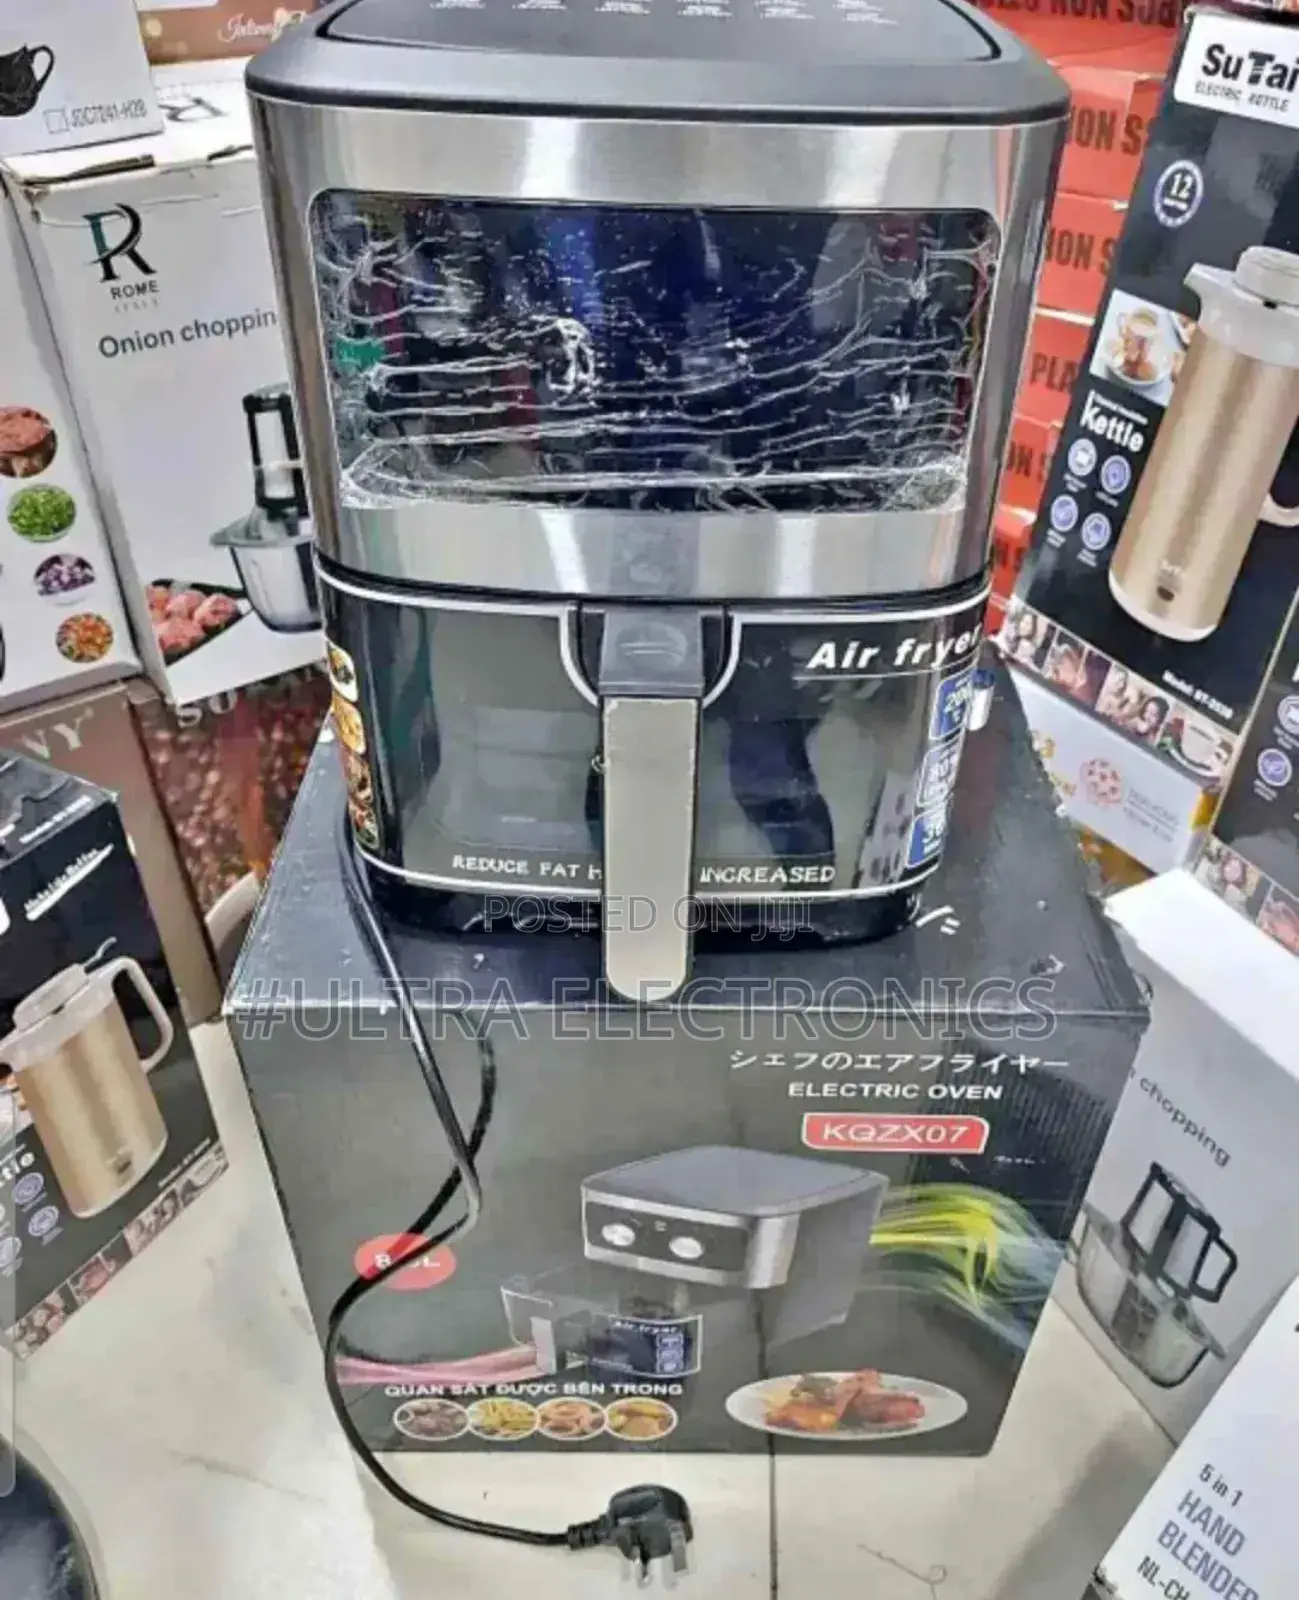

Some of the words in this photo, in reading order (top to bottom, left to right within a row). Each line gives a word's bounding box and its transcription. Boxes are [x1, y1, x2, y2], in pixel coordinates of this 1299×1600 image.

[1171, 172, 1192, 199] 12
[110, 279, 160, 301] ROME
[98, 329, 175, 358] Onion
[1080, 389, 1145, 452] Kettle
[804, 640, 881, 669] Air
[451, 854, 530, 876] REDUCE
[539, 860, 579, 879] FAT
[788, 1082, 921, 1099] ELECTRIC
[927, 1084, 1004, 1100] OVEN
[822, 1123, 970, 1144] KQZX07
[1139, 1077, 1231, 1167] chopping
[384, 1383, 447, 1396] QUAN
[611, 1383, 684, 1396] TRONG
[1199, 1463, 1215, 1483] 5
[1212, 1474, 1229, 1497] in
[1230, 1489, 1243, 1508] 1
[1177, 1489, 1247, 1557] HAND
